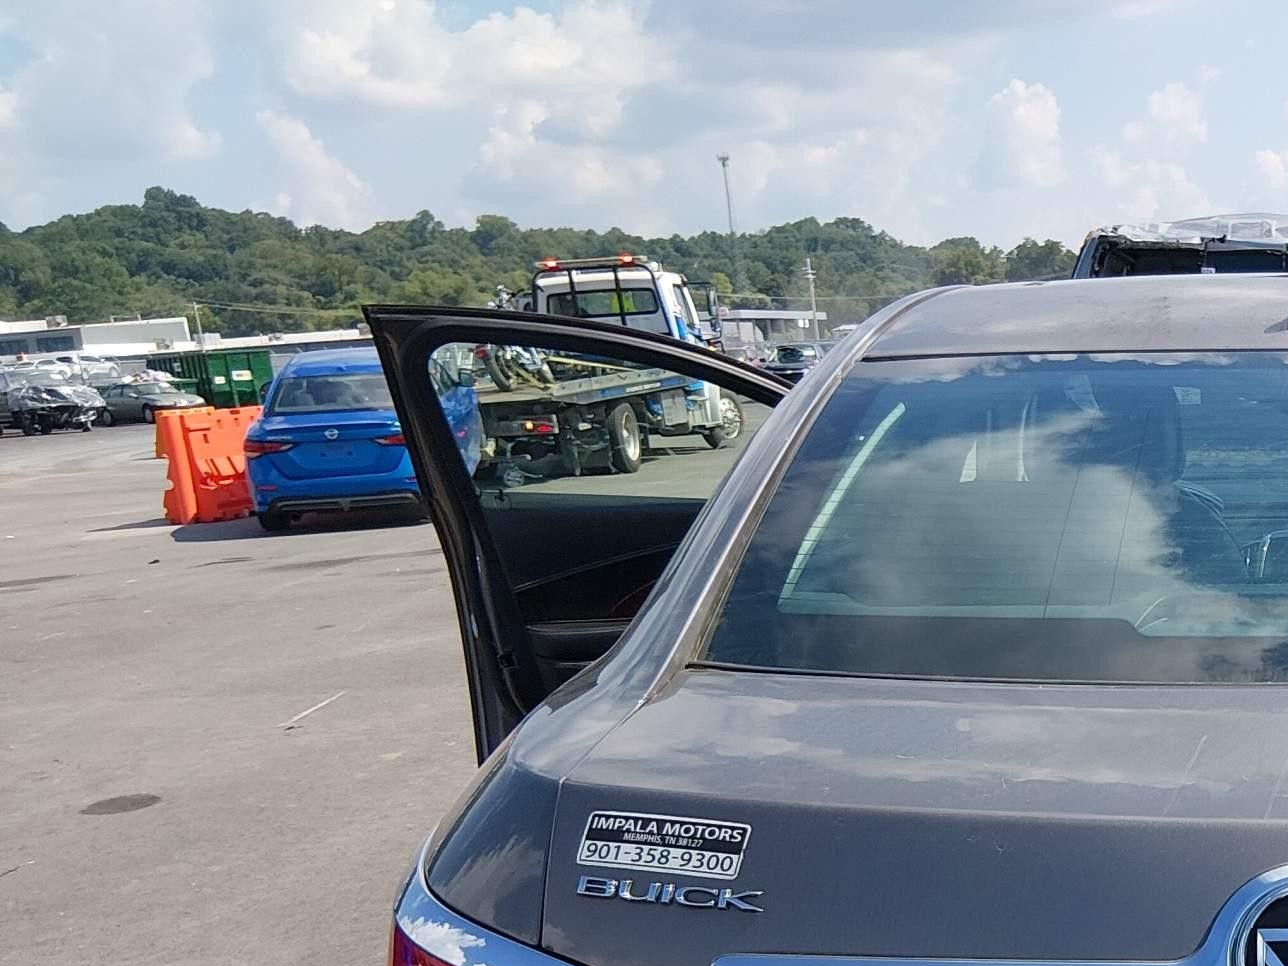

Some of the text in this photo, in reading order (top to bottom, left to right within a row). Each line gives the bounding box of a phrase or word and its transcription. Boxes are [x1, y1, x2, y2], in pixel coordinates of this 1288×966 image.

[592, 817, 743, 843] IMPALA MOTORS
[623, 832, 703, 848] MEMPHIS, TN 38127
[585, 842, 734, 872] 901-358-9300
[576, 875, 764, 912] BUICK
